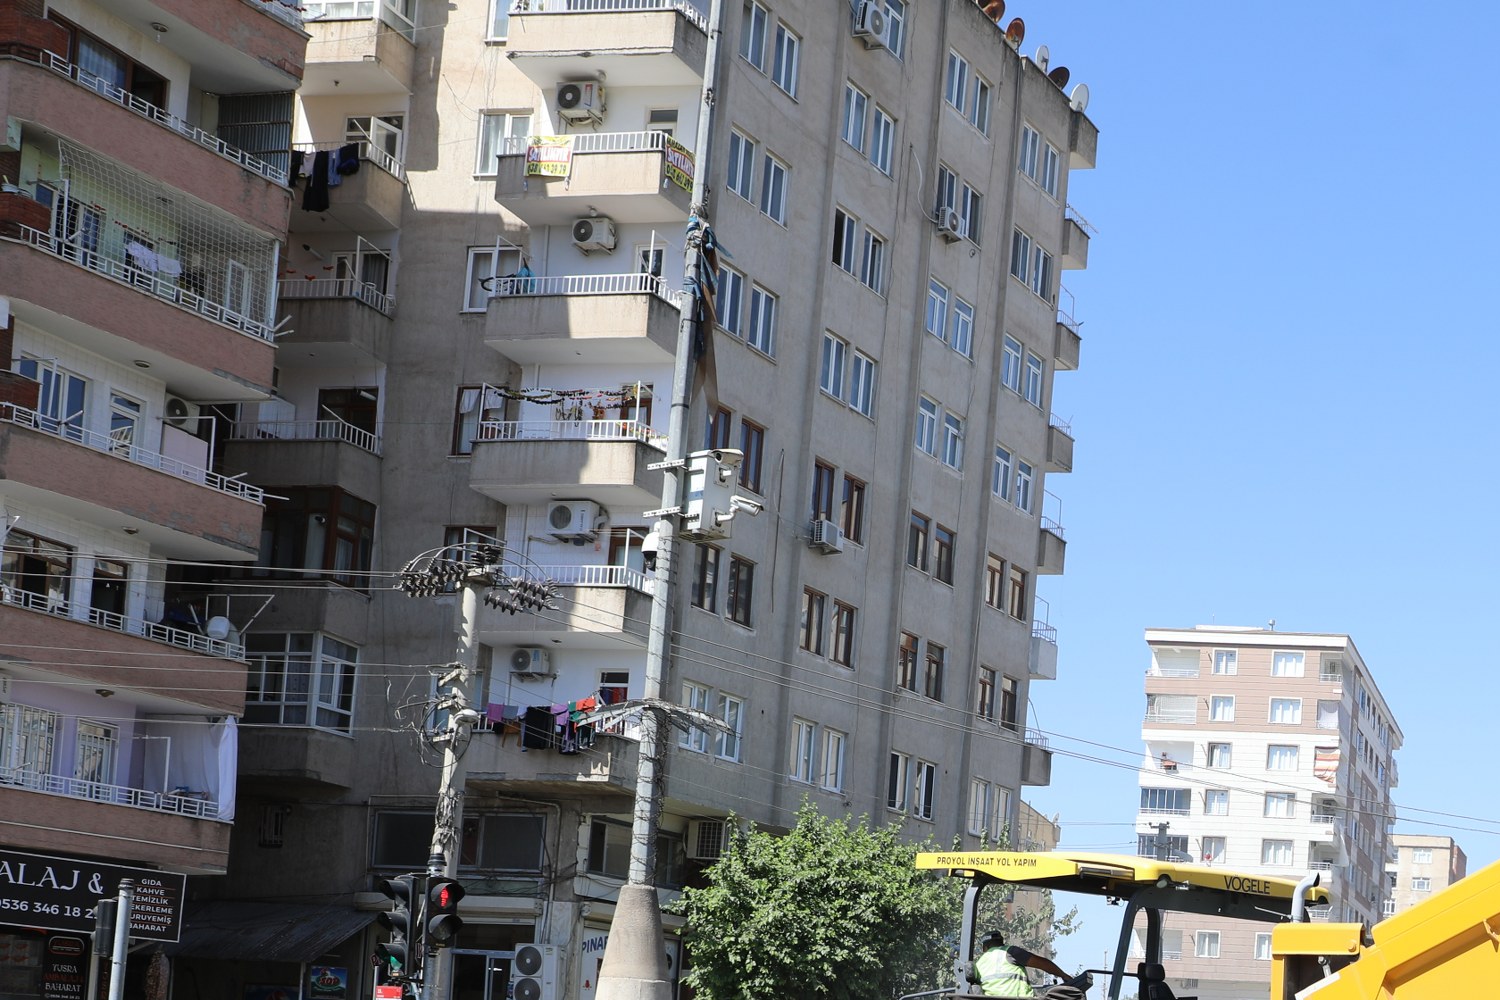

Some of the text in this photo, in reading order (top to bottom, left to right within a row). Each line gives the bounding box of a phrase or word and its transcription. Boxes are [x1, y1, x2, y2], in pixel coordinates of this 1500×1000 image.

[936, 856, 966, 866] PROYOL
[997, 858, 1011, 867] YOL
[1013, 858, 1037, 867] YAPIM
[87, 871, 104, 895] &
[141, 878, 162, 887] GIDA
[1224, 874, 1271, 896] VÖGELE
[136, 886, 165, 896] KAHVE
[0, 898, 98, 920] 536 346 18 2
[131, 903, 174, 915] EKERLEME
[44, 982, 82, 993] BAHARAT
